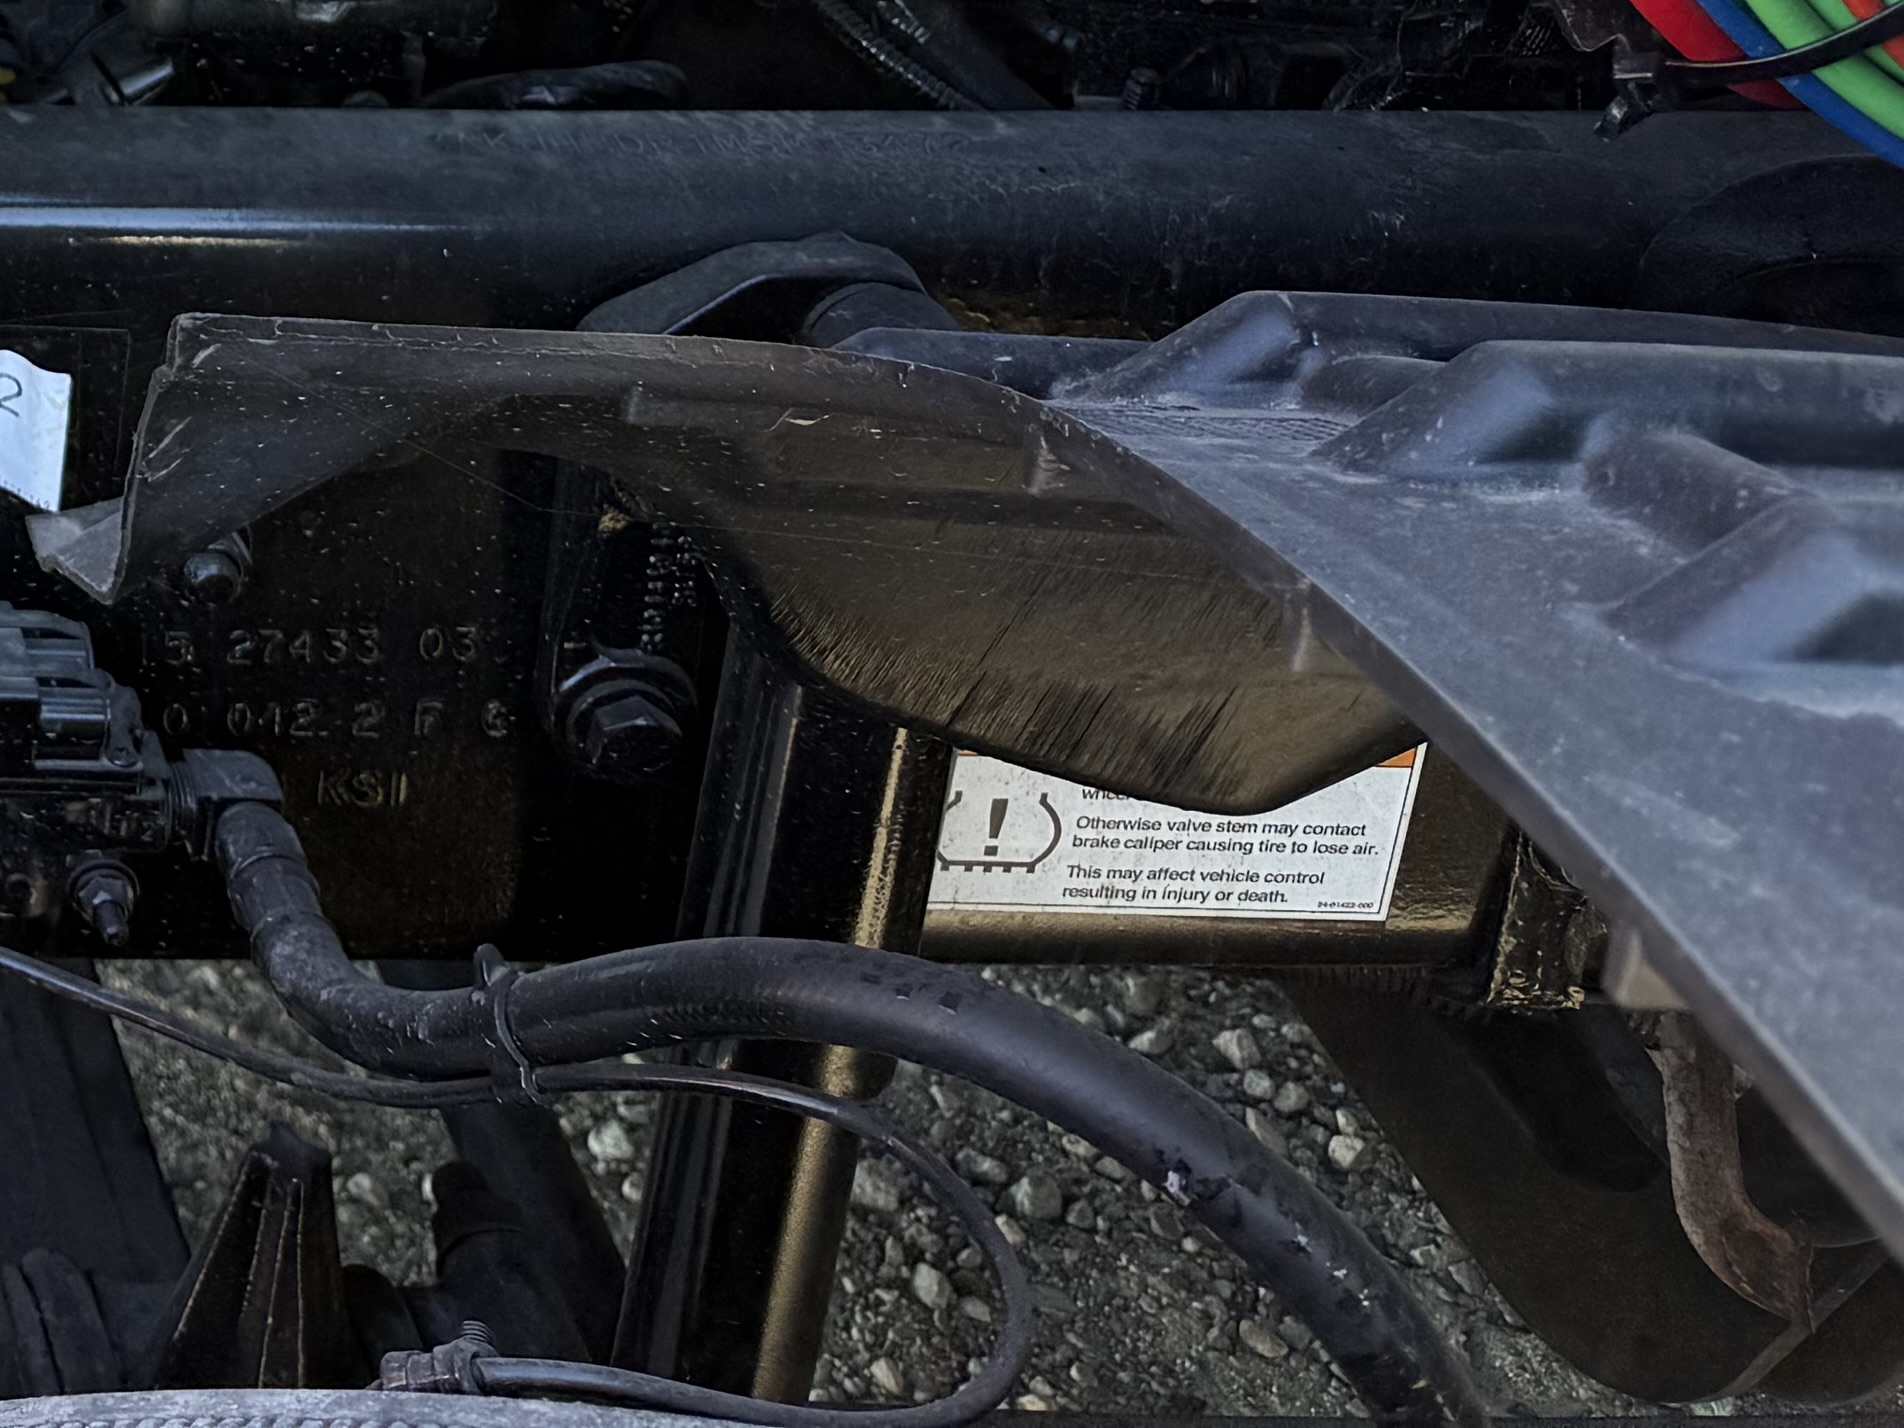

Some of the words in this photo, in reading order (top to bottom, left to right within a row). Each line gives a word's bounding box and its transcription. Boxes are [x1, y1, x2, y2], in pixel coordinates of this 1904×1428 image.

[1076, 815, 1162, 832] Otherwise
[1166, 818, 1213, 833] valve
[1215, 821, 1258, 834] stem
[1262, 823, 1299, 837] may
[1302, 824, 1367, 837] contact
[1072, 834, 1121, 849] brake
[1124, 836, 1184, 853] caliper
[1186, 840, 1255, 855] causing
[1258, 839, 1287, 853] tire
[1291, 841, 1308, 855] to
[1312, 842, 1349, 855] lose
[1352, 843, 1380, 856] air.
[1067, 864, 1103, 880] This
[1106, 867, 1144, 883] may
[1146, 866, 1196, 882] affect
[1200, 867, 1260, 884] vehicle
[1263, 870, 1326, 885] control
[1062, 885, 1138, 903] resulting
[1142, 886, 1157, 900] in
[1162, 885, 1211, 905] injury
[1214, 890, 1234, 902] or
[1237, 889, 1289, 904] death.
